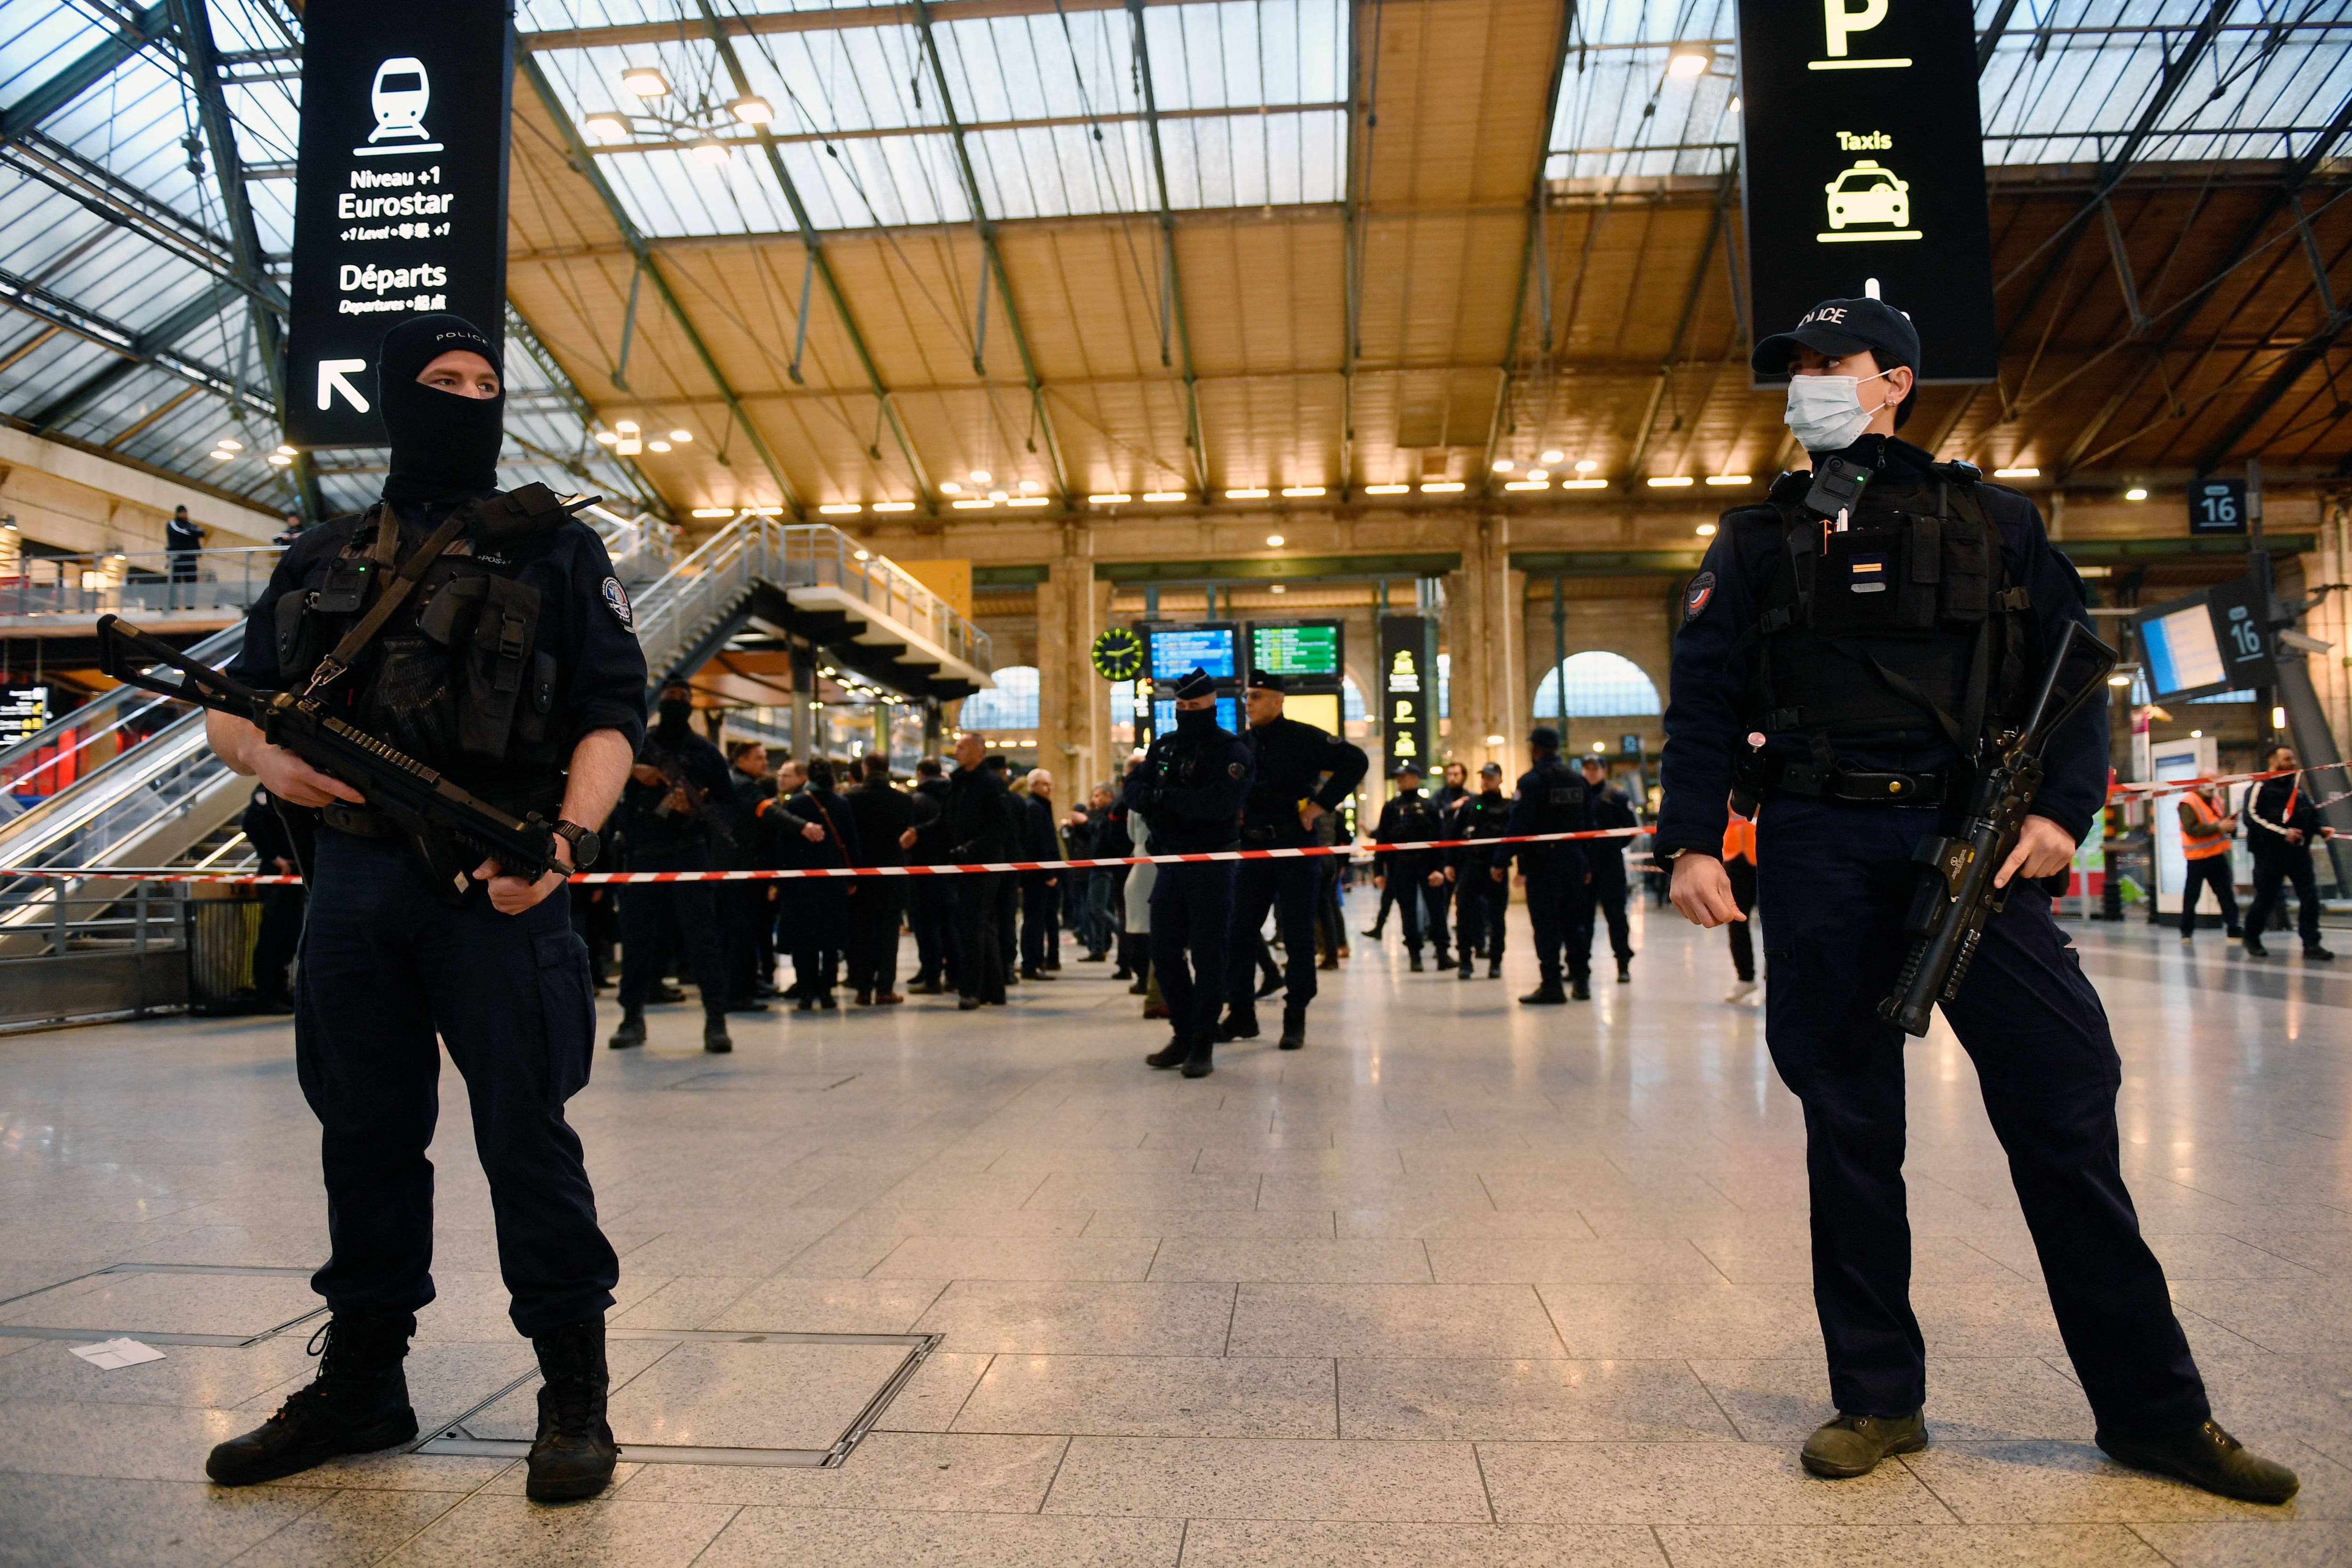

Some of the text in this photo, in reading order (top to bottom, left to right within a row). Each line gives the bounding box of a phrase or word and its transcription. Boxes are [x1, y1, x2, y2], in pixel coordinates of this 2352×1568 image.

[1824, 0, 1889, 56] P
[1836, 130, 1892, 151] Taxis
[350, 166, 440, 189] Niveau +1
[338, 191, 454, 219] Eurostar
[341, 227, 357, 241] +1
[357, 225, 390, 240] Level
[433, 222, 450, 236] +1
[340, 263, 447, 295] Départs
[338, 299, 405, 316] Departures
[1796, 307, 1848, 329] OLICE
[436, 331, 489, 346] POLICE
[2200, 496, 2236, 522] 16
[2230, 620, 2261, 655] 16
